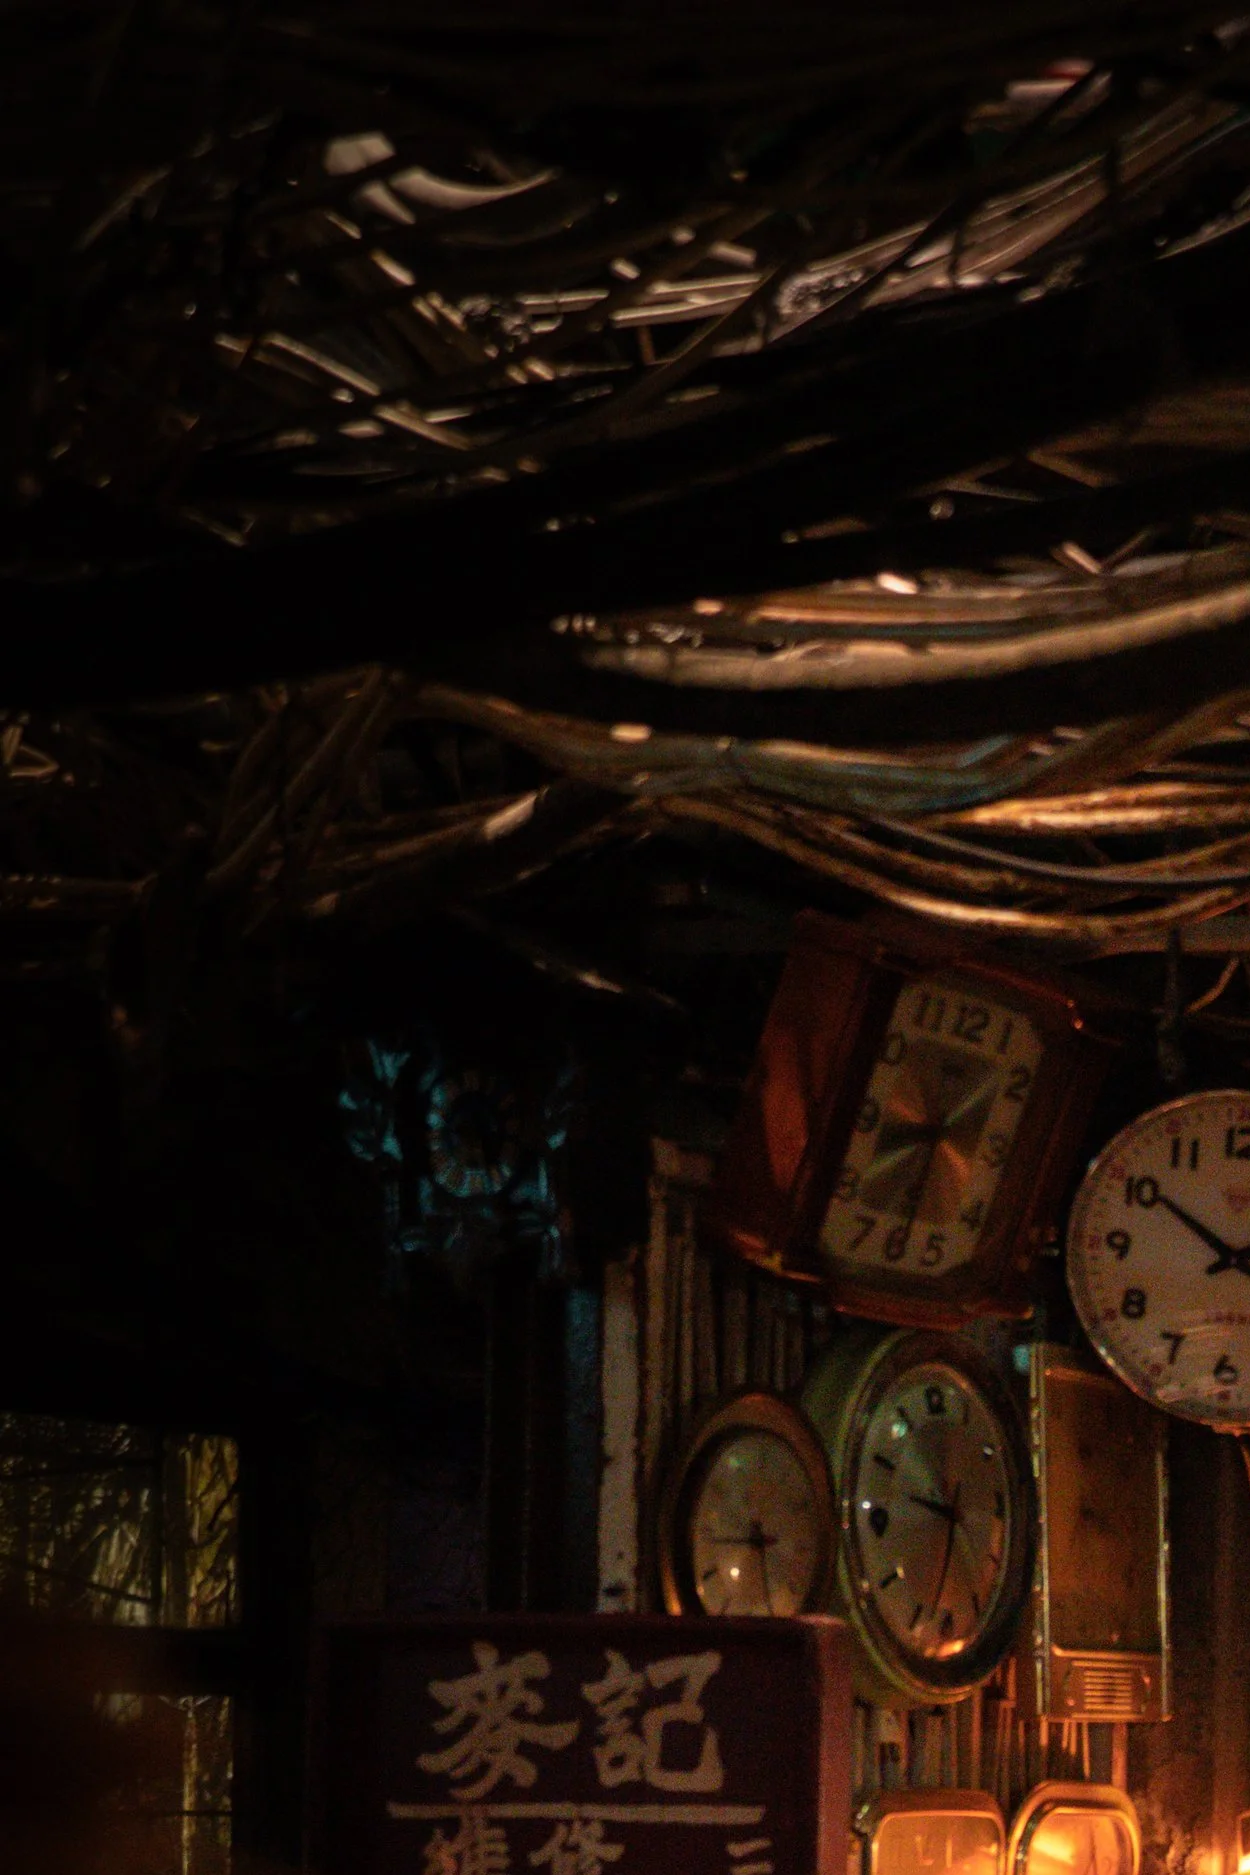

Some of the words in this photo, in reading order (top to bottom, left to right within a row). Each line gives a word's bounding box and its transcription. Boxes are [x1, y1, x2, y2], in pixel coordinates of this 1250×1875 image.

[912, 992, 946, 1033] 11
[953, 1006, 991, 1044] 12
[1004, 1064, 1030, 1103] 2
[1170, 1137, 1200, 1171] 11
[1125, 1176, 1159, 1209] 10
[848, 1214, 878, 1250] 7
[1106, 1230, 1132, 1260] 9
[921, 1232, 945, 1267] 5
[1120, 1288, 1147, 1320] 8
[1160, 1331, 1186, 1365] 7
[1213, 1354, 1239, 1386] 6
[416, 1641, 725, 1799] 麥記
